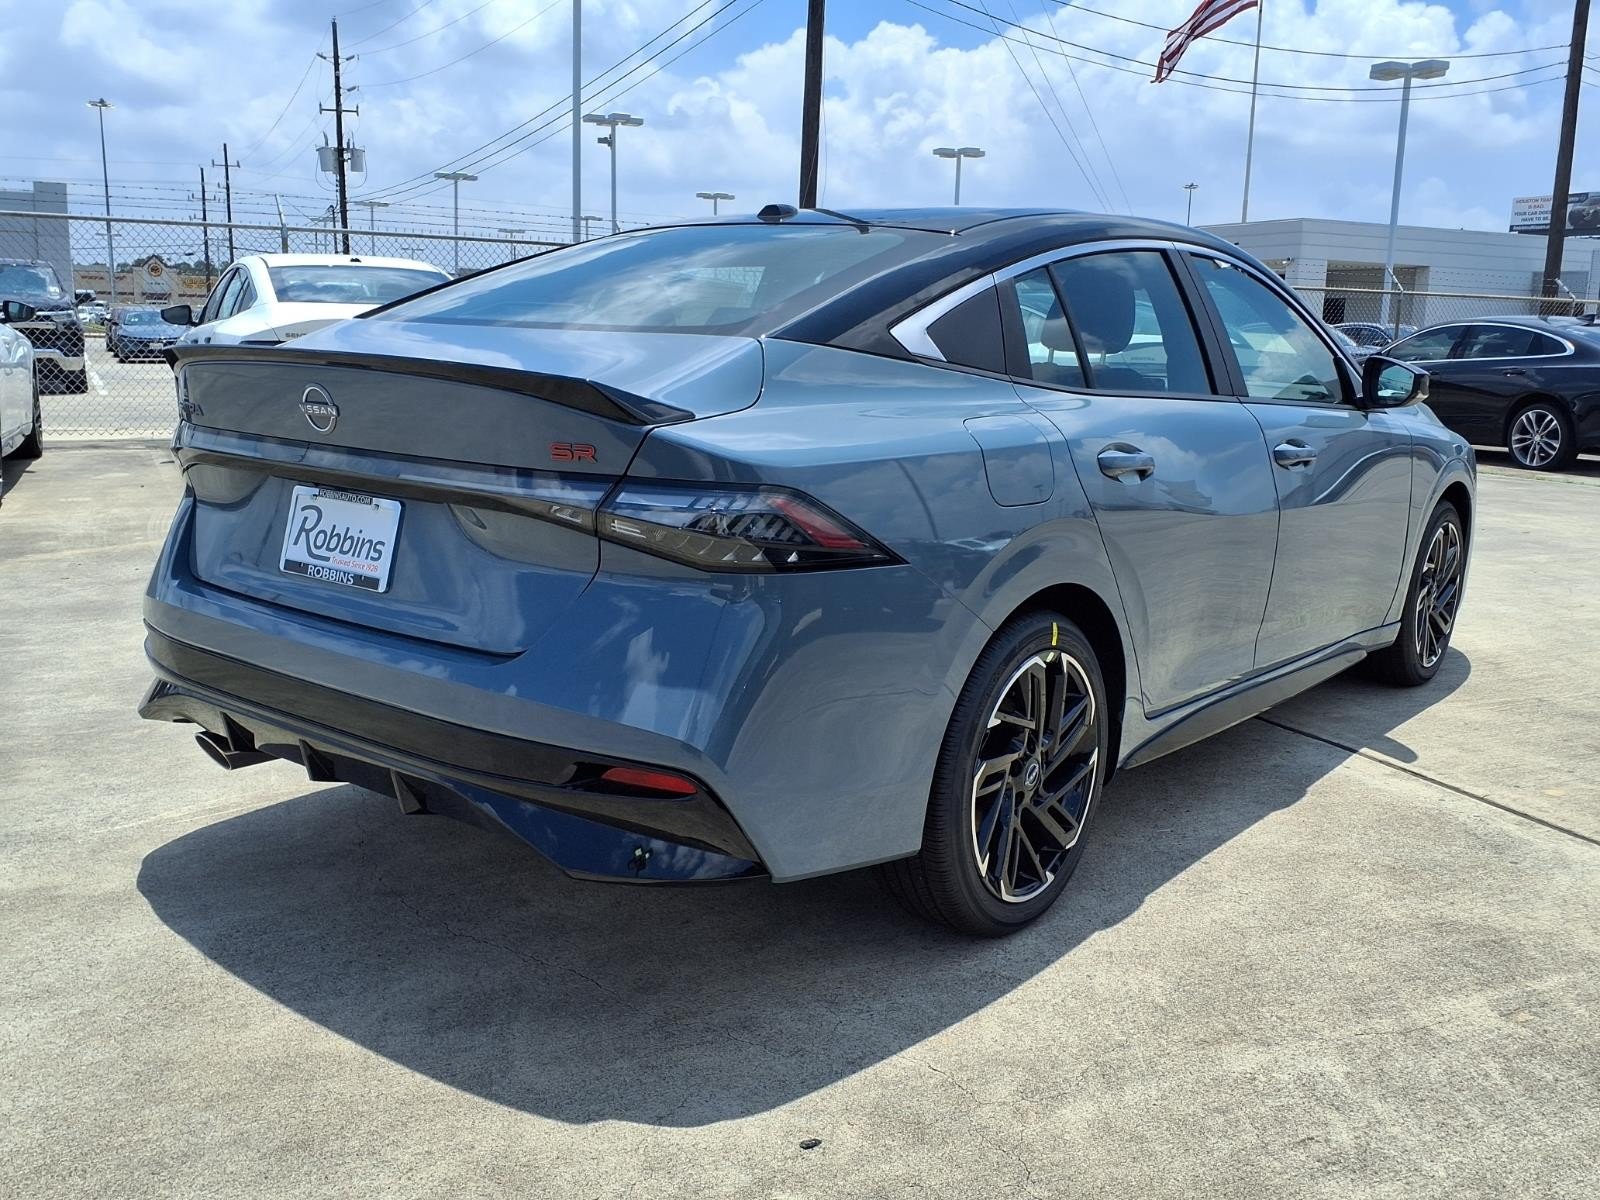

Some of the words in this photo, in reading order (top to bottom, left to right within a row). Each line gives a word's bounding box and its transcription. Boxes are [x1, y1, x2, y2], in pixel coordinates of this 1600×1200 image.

[299, 404, 336, 416] NISSAN
[550, 442, 597, 464] SR
[319, 488, 372, 505] ROBBINSAUTO.COM
[293, 505, 386, 562] Robbins
[331, 556, 351, 567] Trusted
[351, 561, 366, 570] Since
[308, 565, 354, 585] ROBBINS
